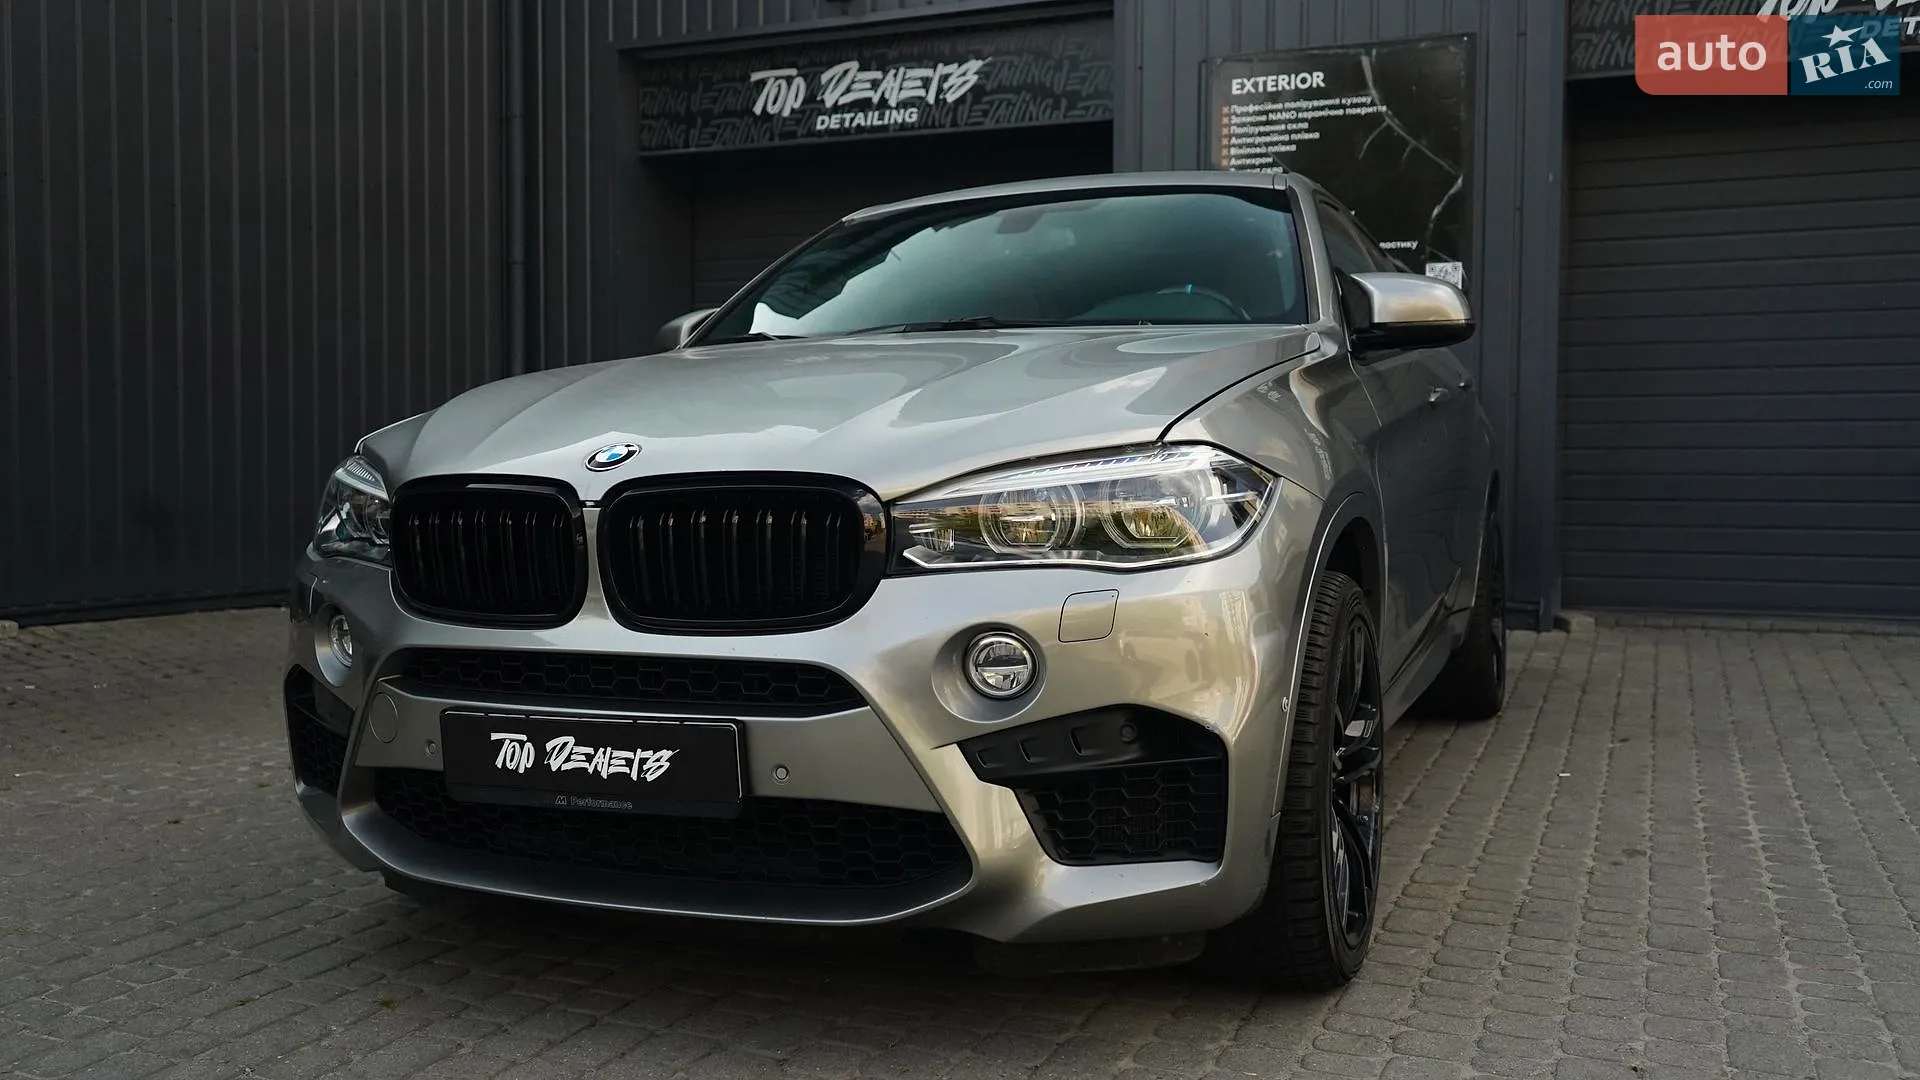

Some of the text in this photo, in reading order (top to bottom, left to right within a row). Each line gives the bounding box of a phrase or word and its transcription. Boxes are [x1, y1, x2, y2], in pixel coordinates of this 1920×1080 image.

[1231, 71, 1326, 95] EXTERIOR
[815, 108, 919, 131] DETAILING
[1268, 111, 1297, 121] NANO
[570, 796, 633, 810] Performance
